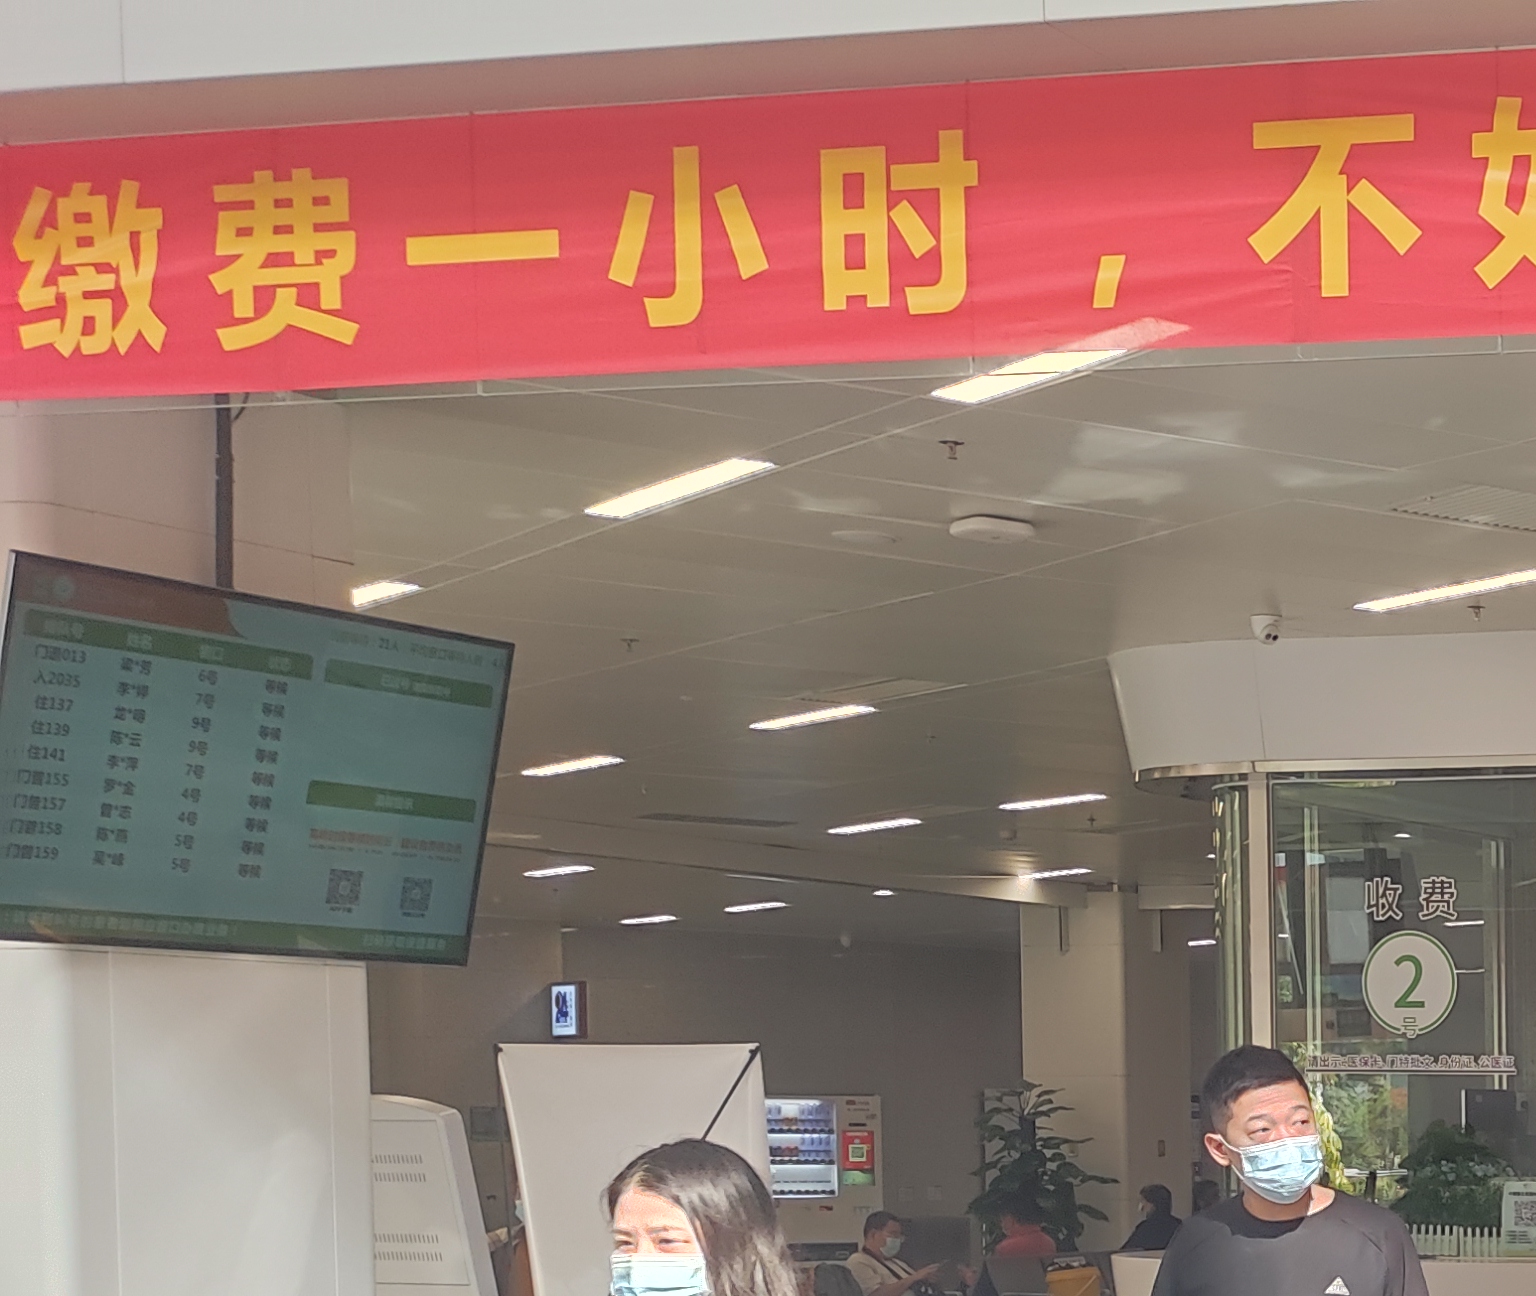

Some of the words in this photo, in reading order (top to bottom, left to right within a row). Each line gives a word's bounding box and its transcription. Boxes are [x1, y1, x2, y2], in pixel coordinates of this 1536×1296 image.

[1365, 877, 1458, 921] 收费
[1393, 955, 1425, 1009] 2
[1400, 1016, 1424, 1038] 号
